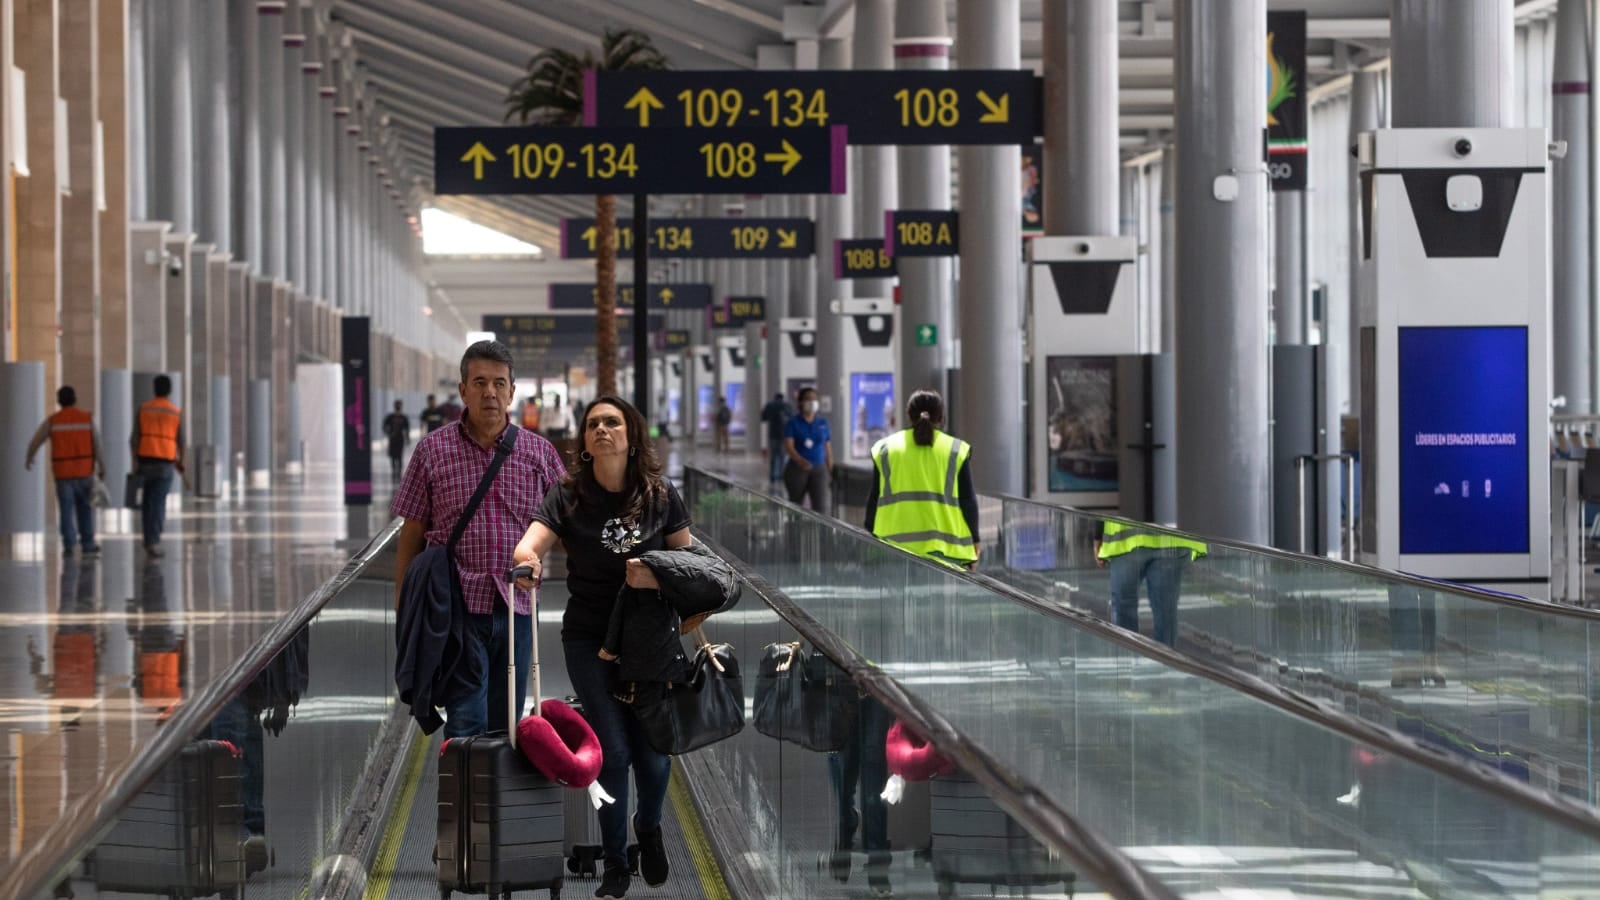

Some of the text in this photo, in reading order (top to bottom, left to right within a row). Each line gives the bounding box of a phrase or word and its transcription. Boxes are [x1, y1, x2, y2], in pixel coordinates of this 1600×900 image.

[677, 88, 960, 128] 109-134 108
[506, 142, 757, 179] 109-134 108
[731, 226, 769, 250] 109
[897, 222, 952, 245] 108 A
[844, 248, 876, 270] 108
[1438, 433, 1446, 445] EN
[1446, 433, 1473, 445] ESPACIOS
[1474, 433, 1516, 445] PUBLICITARIOS
